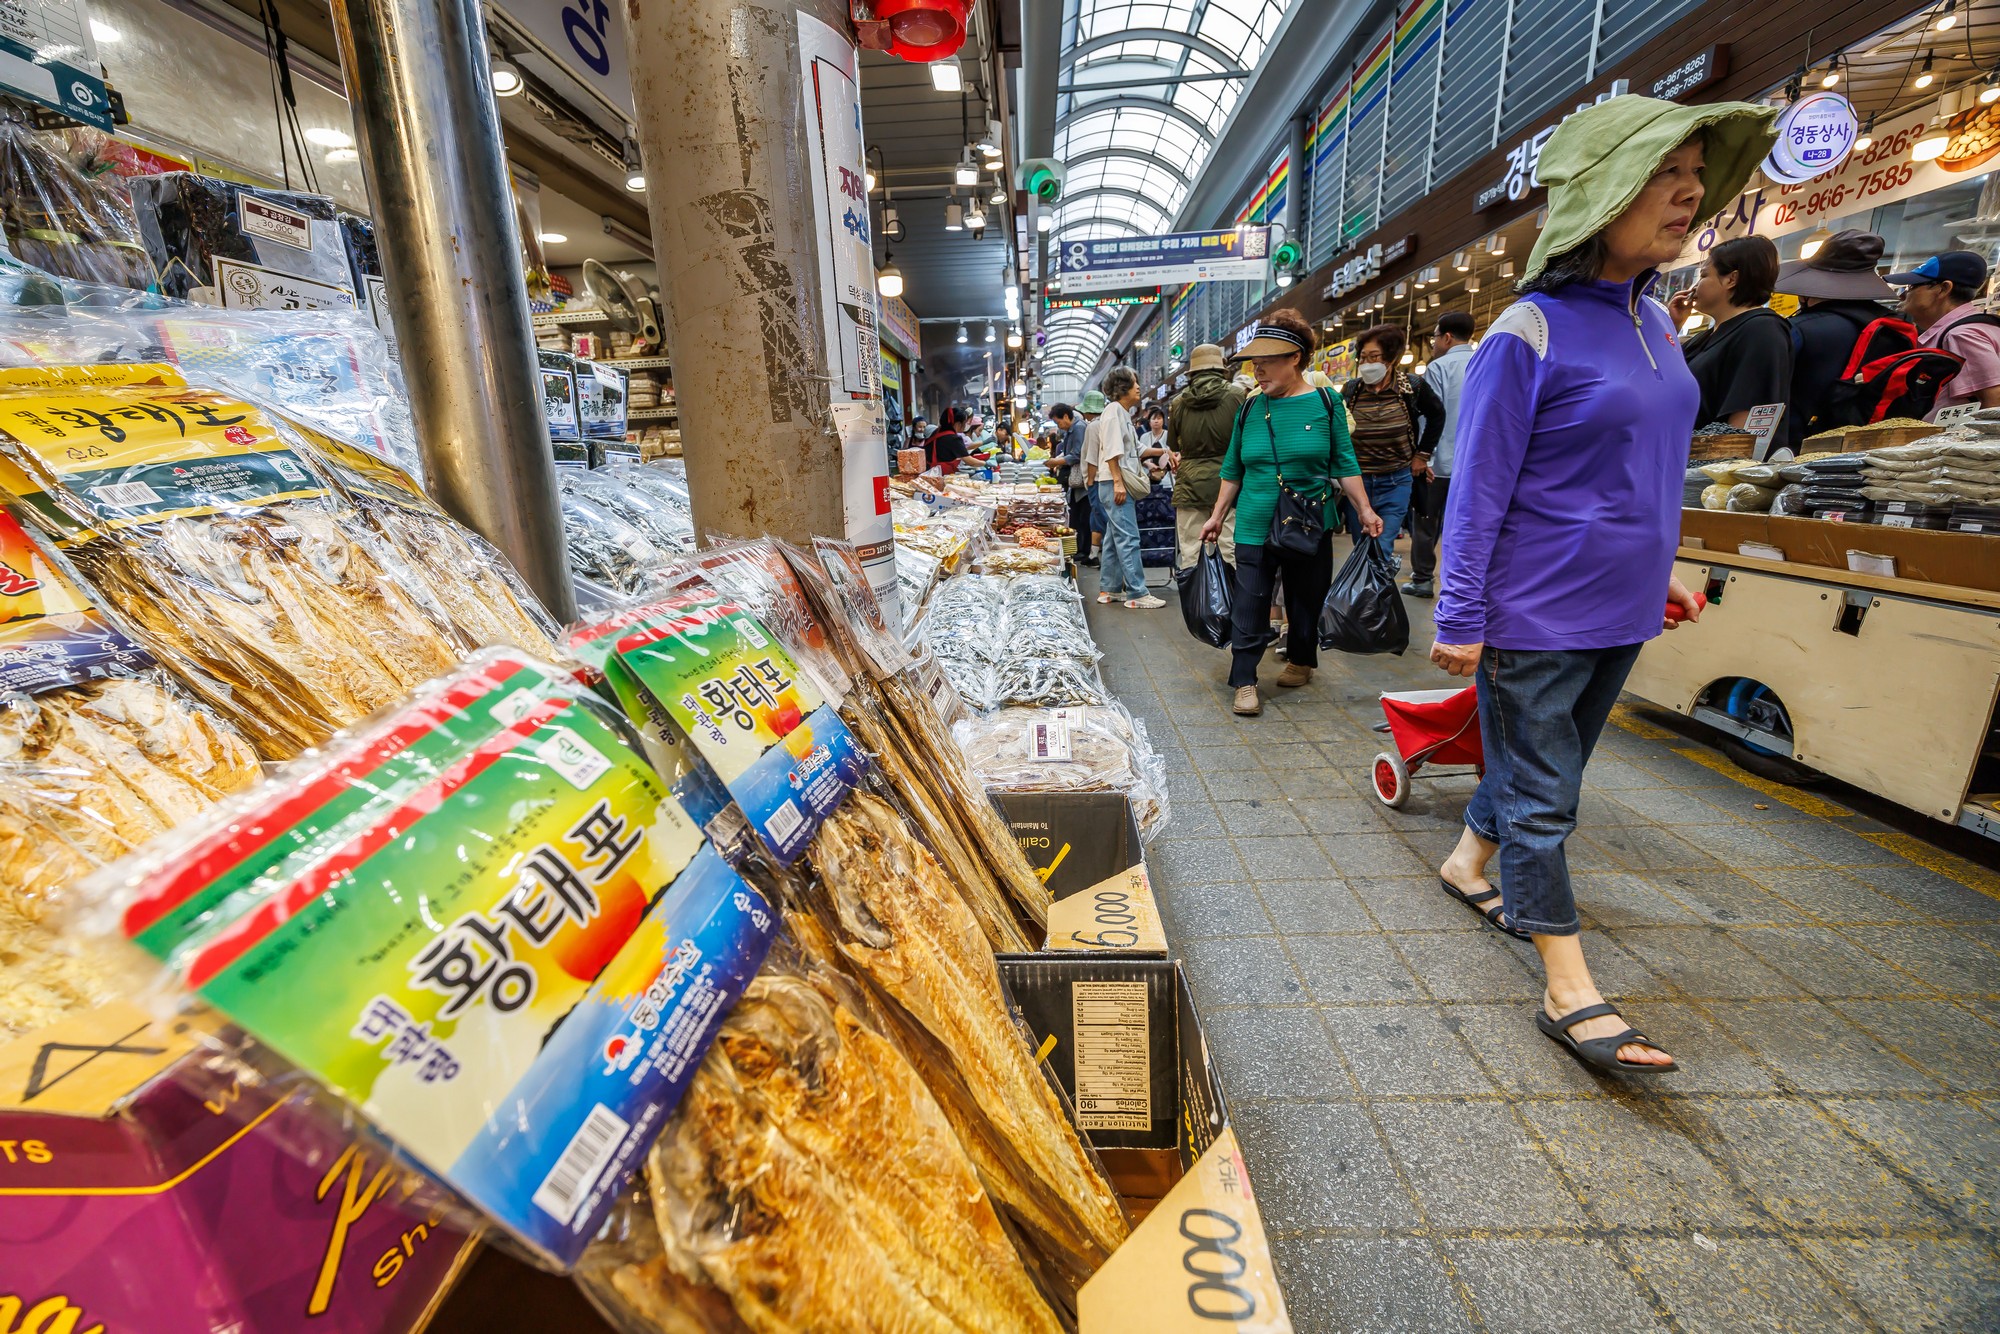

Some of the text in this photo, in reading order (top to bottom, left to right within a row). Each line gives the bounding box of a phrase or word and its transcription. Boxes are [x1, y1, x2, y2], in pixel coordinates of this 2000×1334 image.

[1653, 53, 1707, 94] 02-967-8263
[1791, 122, 1851, 145] 경동상사
[1807, 150, 1827, 159] 나-28
[1774, 161, 1913, 226] 02-966-7585
[262, 218, 293, 235] 30,000
[270, 209, 292, 225] 곱창김
[1181, 236, 1200, 248] 가게
[47, 400, 247, 443] 황태포
[698, 659, 792, 731] 황태포
[681, 693, 728, 746] 대관령
[797, 743, 833, 780] 동화수산
[418, 800, 645, 1015] 황태포
[630, 939, 704, 1029] 동화수산
[359, 997, 462, 1085] 대관령
[1080, 1100, 1098, 1109] 190
[1116, 1100, 1148, 1108] Calories
